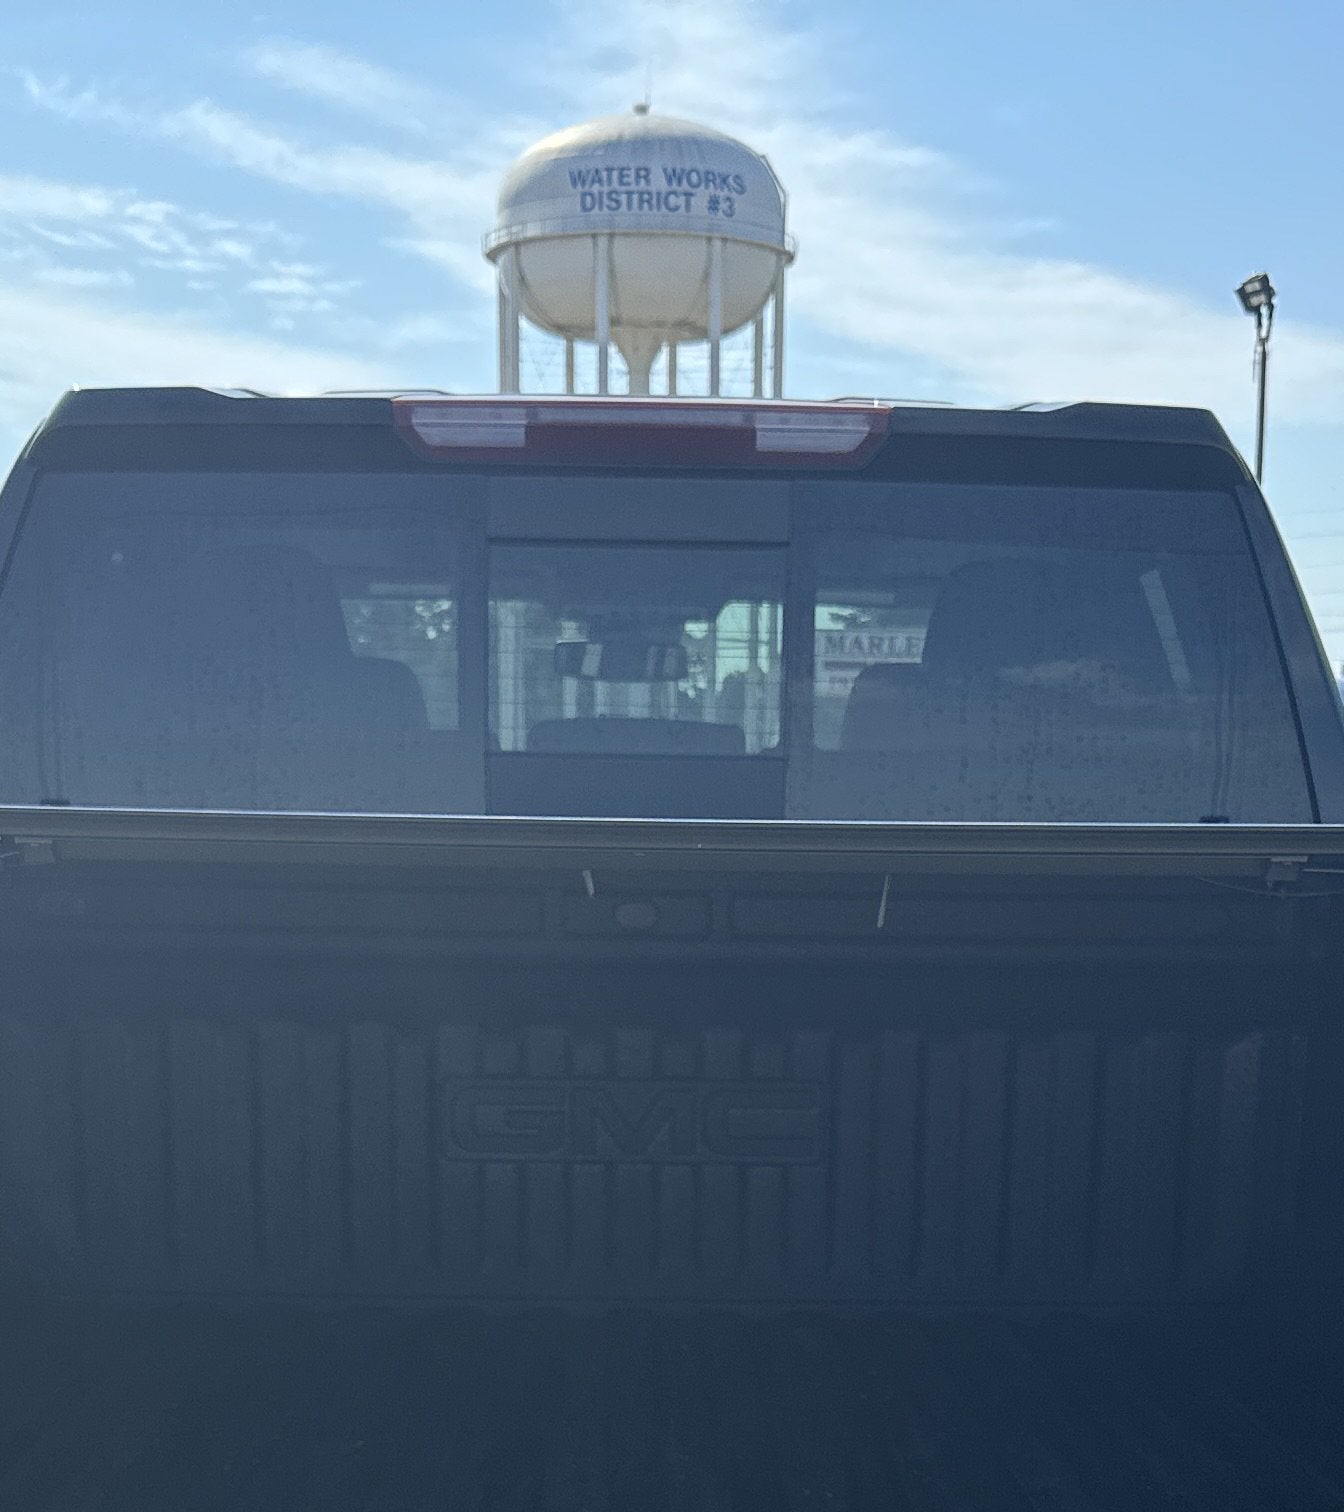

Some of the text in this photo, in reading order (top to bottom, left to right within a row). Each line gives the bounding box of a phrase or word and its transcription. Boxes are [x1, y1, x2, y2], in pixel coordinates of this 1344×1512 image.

[568, 167, 747, 195] WATER WORKS
[579, 190, 736, 218] DISTRICT #3
[451, 1083, 821, 1160] GMC
